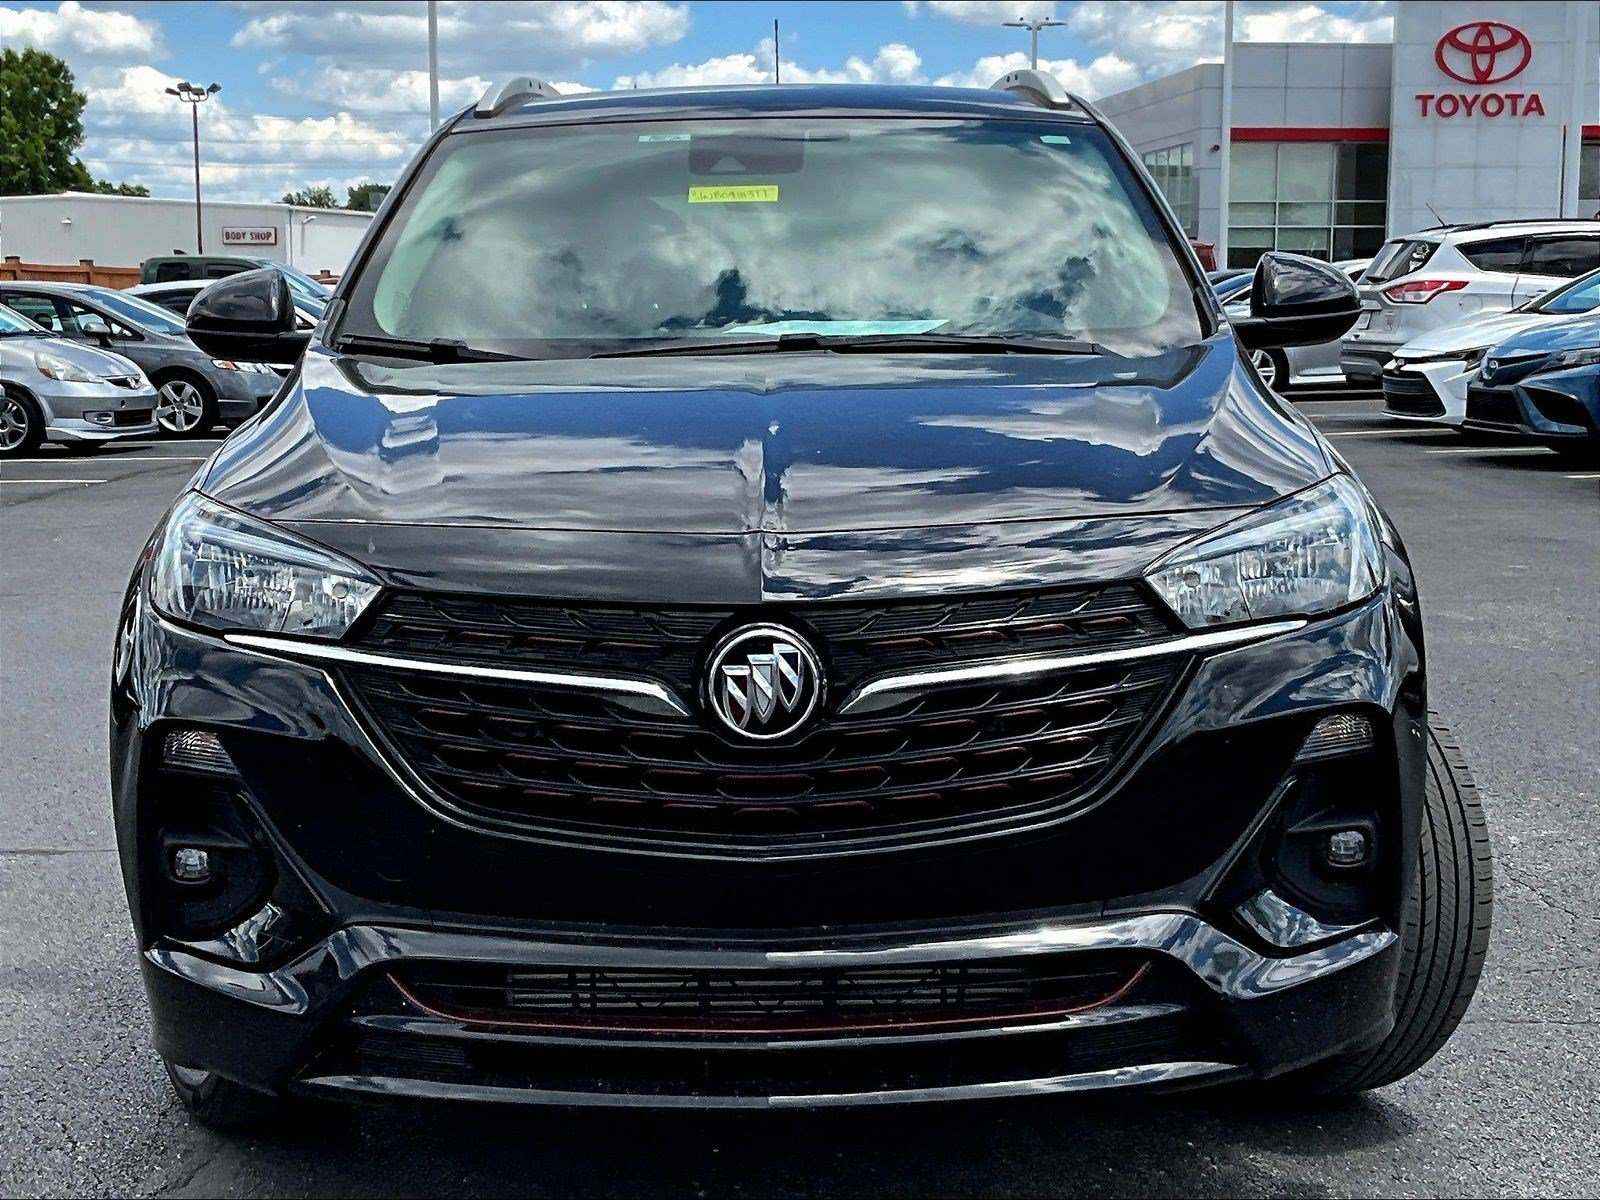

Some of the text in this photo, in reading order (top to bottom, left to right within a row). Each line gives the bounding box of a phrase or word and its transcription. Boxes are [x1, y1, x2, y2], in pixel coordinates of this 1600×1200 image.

[1415, 93, 1545, 118] TOYOTA
[225, 231, 272, 240] BODY SHOP
